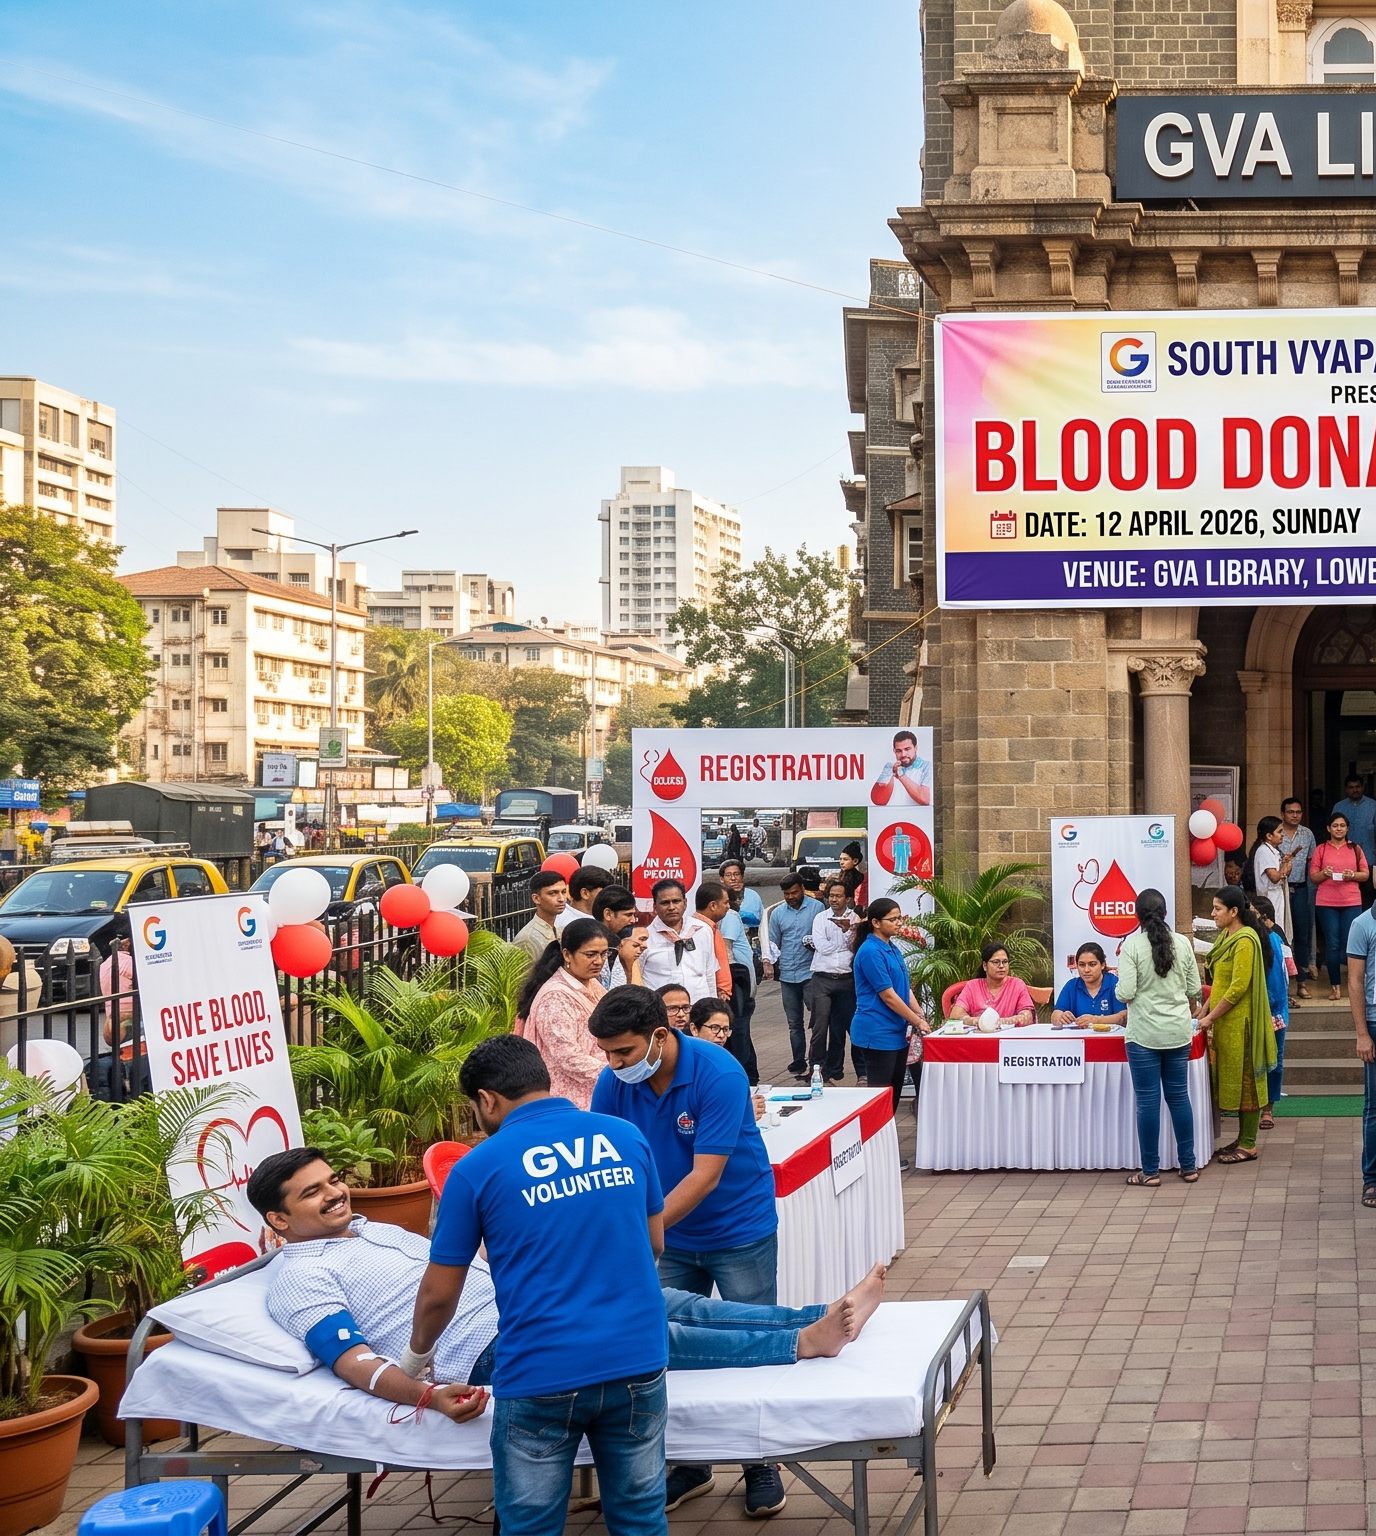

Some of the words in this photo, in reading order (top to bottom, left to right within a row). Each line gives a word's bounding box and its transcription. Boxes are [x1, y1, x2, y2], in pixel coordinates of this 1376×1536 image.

[1144, 111, 1293, 178] GVA
[1167, 340, 1277, 377] SOUTH
[975, 417, 1197, 493] BLOOD
[1025, 511, 1087, 538] DATE:
[1095, 511, 1122, 537] 12
[1128, 510, 1194, 537] APRIL
[1199, 508, 1266, 539] 2026,
[1272, 507, 1362, 535] SUNDAY
[1063, 560, 1146, 588] VENUE:
[1153, 559, 1200, 588] GVA
[1206, 558, 1309, 589] LIBRARY,
[700, 753, 865, 782] REGISTRATION
[1093, 901, 1136, 916] HERO
[160, 1001, 207, 1043] GIVE
[208, 990, 272, 1033] BLOOD,
[171, 1042, 223, 1086] SAVE
[224, 1030, 275, 1073] LIVES
[1003, 1056, 1081, 1067] REGISTRATION
[522, 1133, 622, 1178] GVA
[521, 1166, 635, 1207] VOLUNTEER
